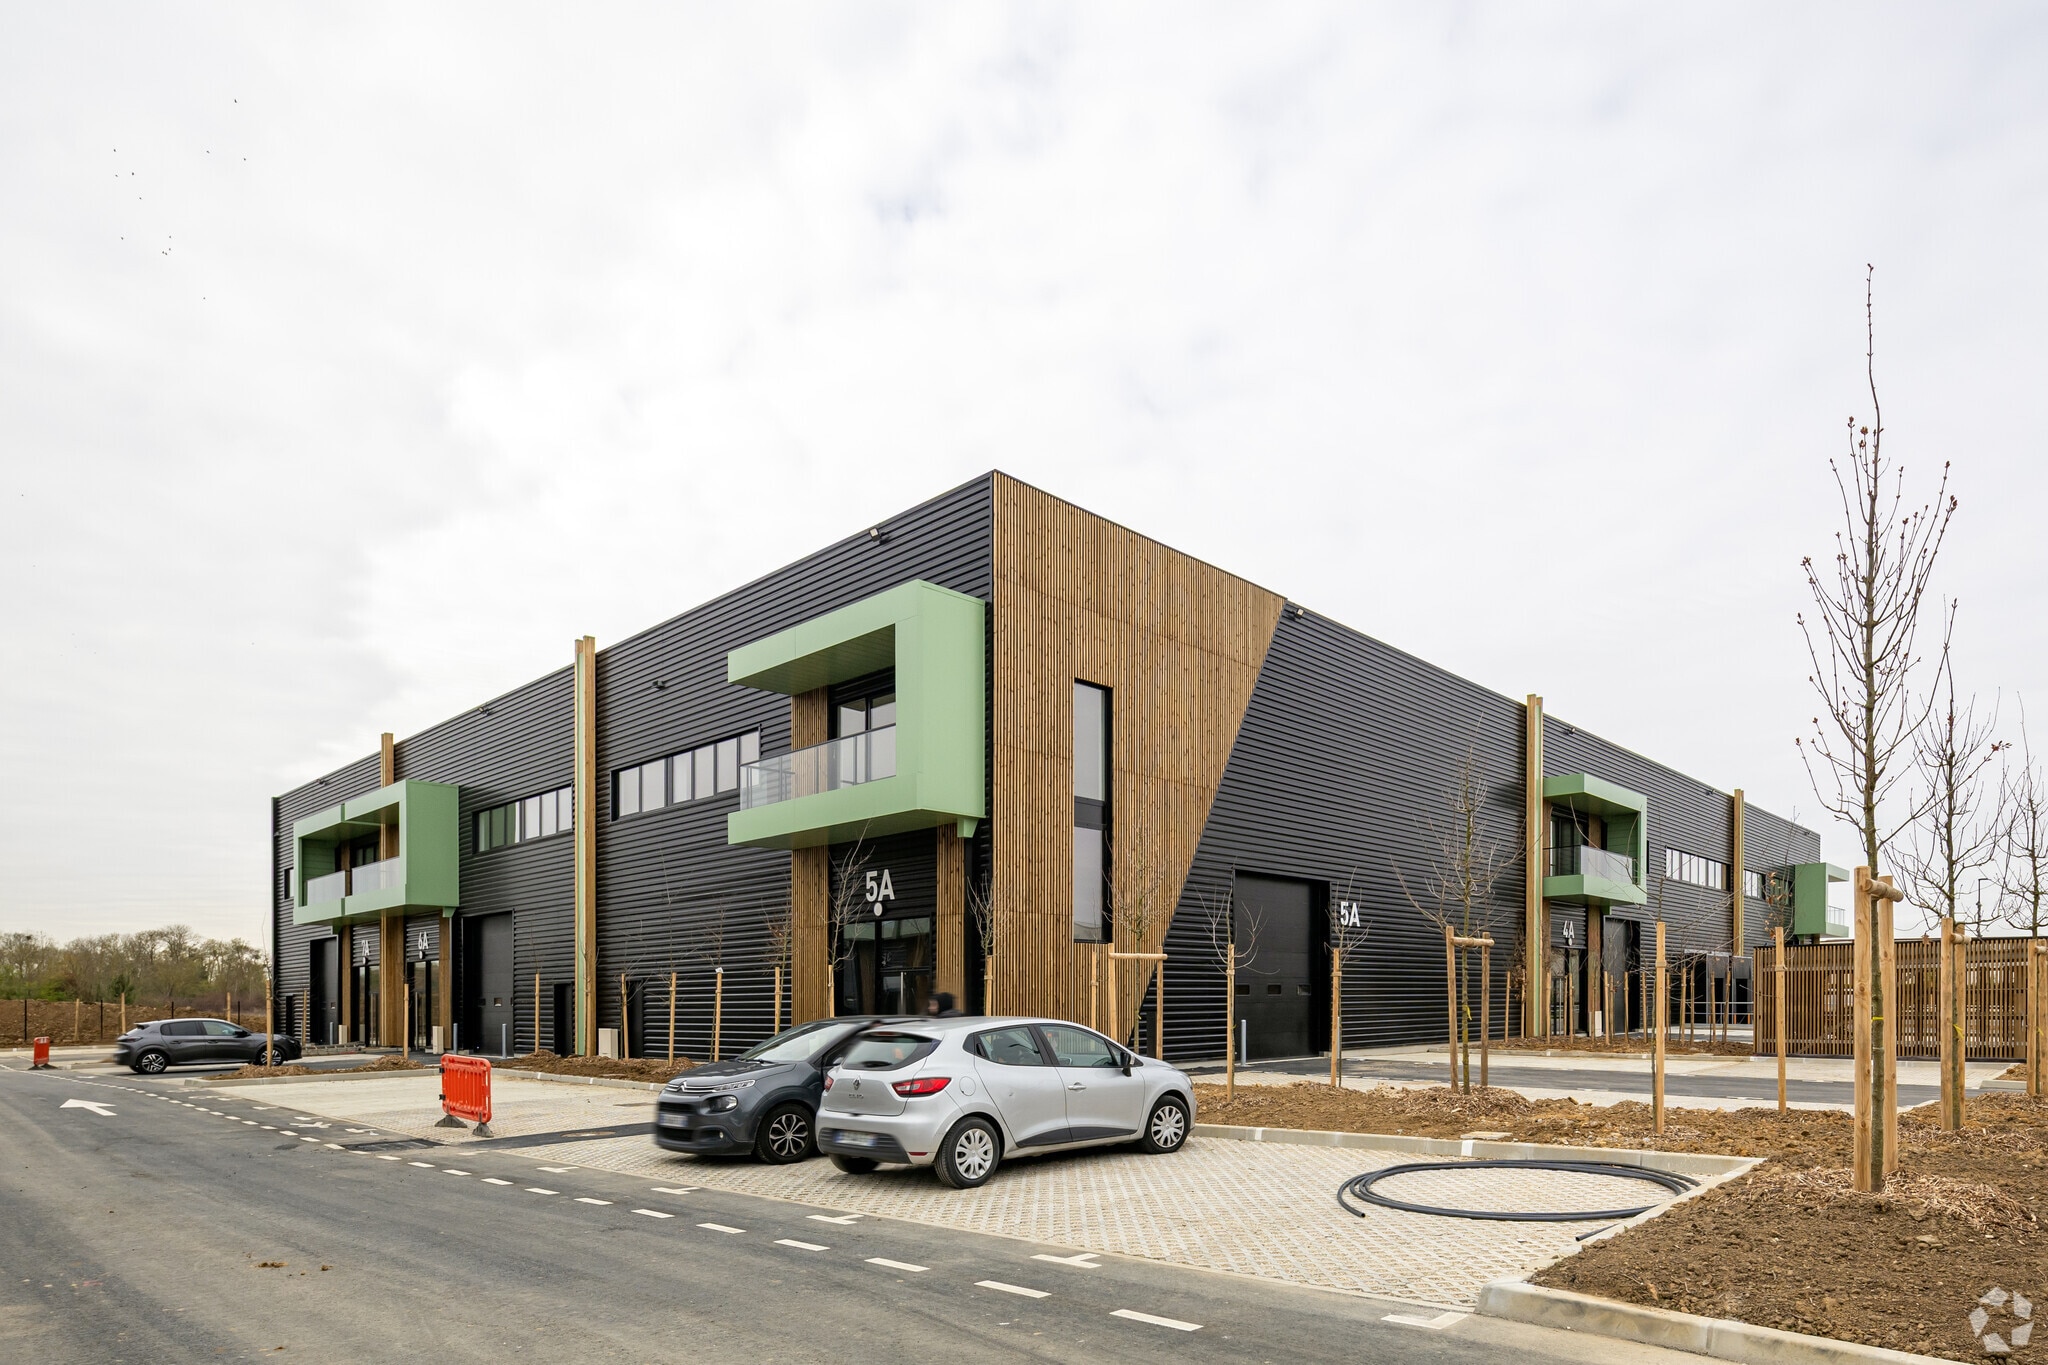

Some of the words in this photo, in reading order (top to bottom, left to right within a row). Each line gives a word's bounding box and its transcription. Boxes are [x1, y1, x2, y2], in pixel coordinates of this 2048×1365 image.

[866, 869, 895, 902] 5A
[1340, 901, 1360, 927] 5A
[418, 931, 429, 949] 6A
[1563, 920, 1575, 939] 4A
